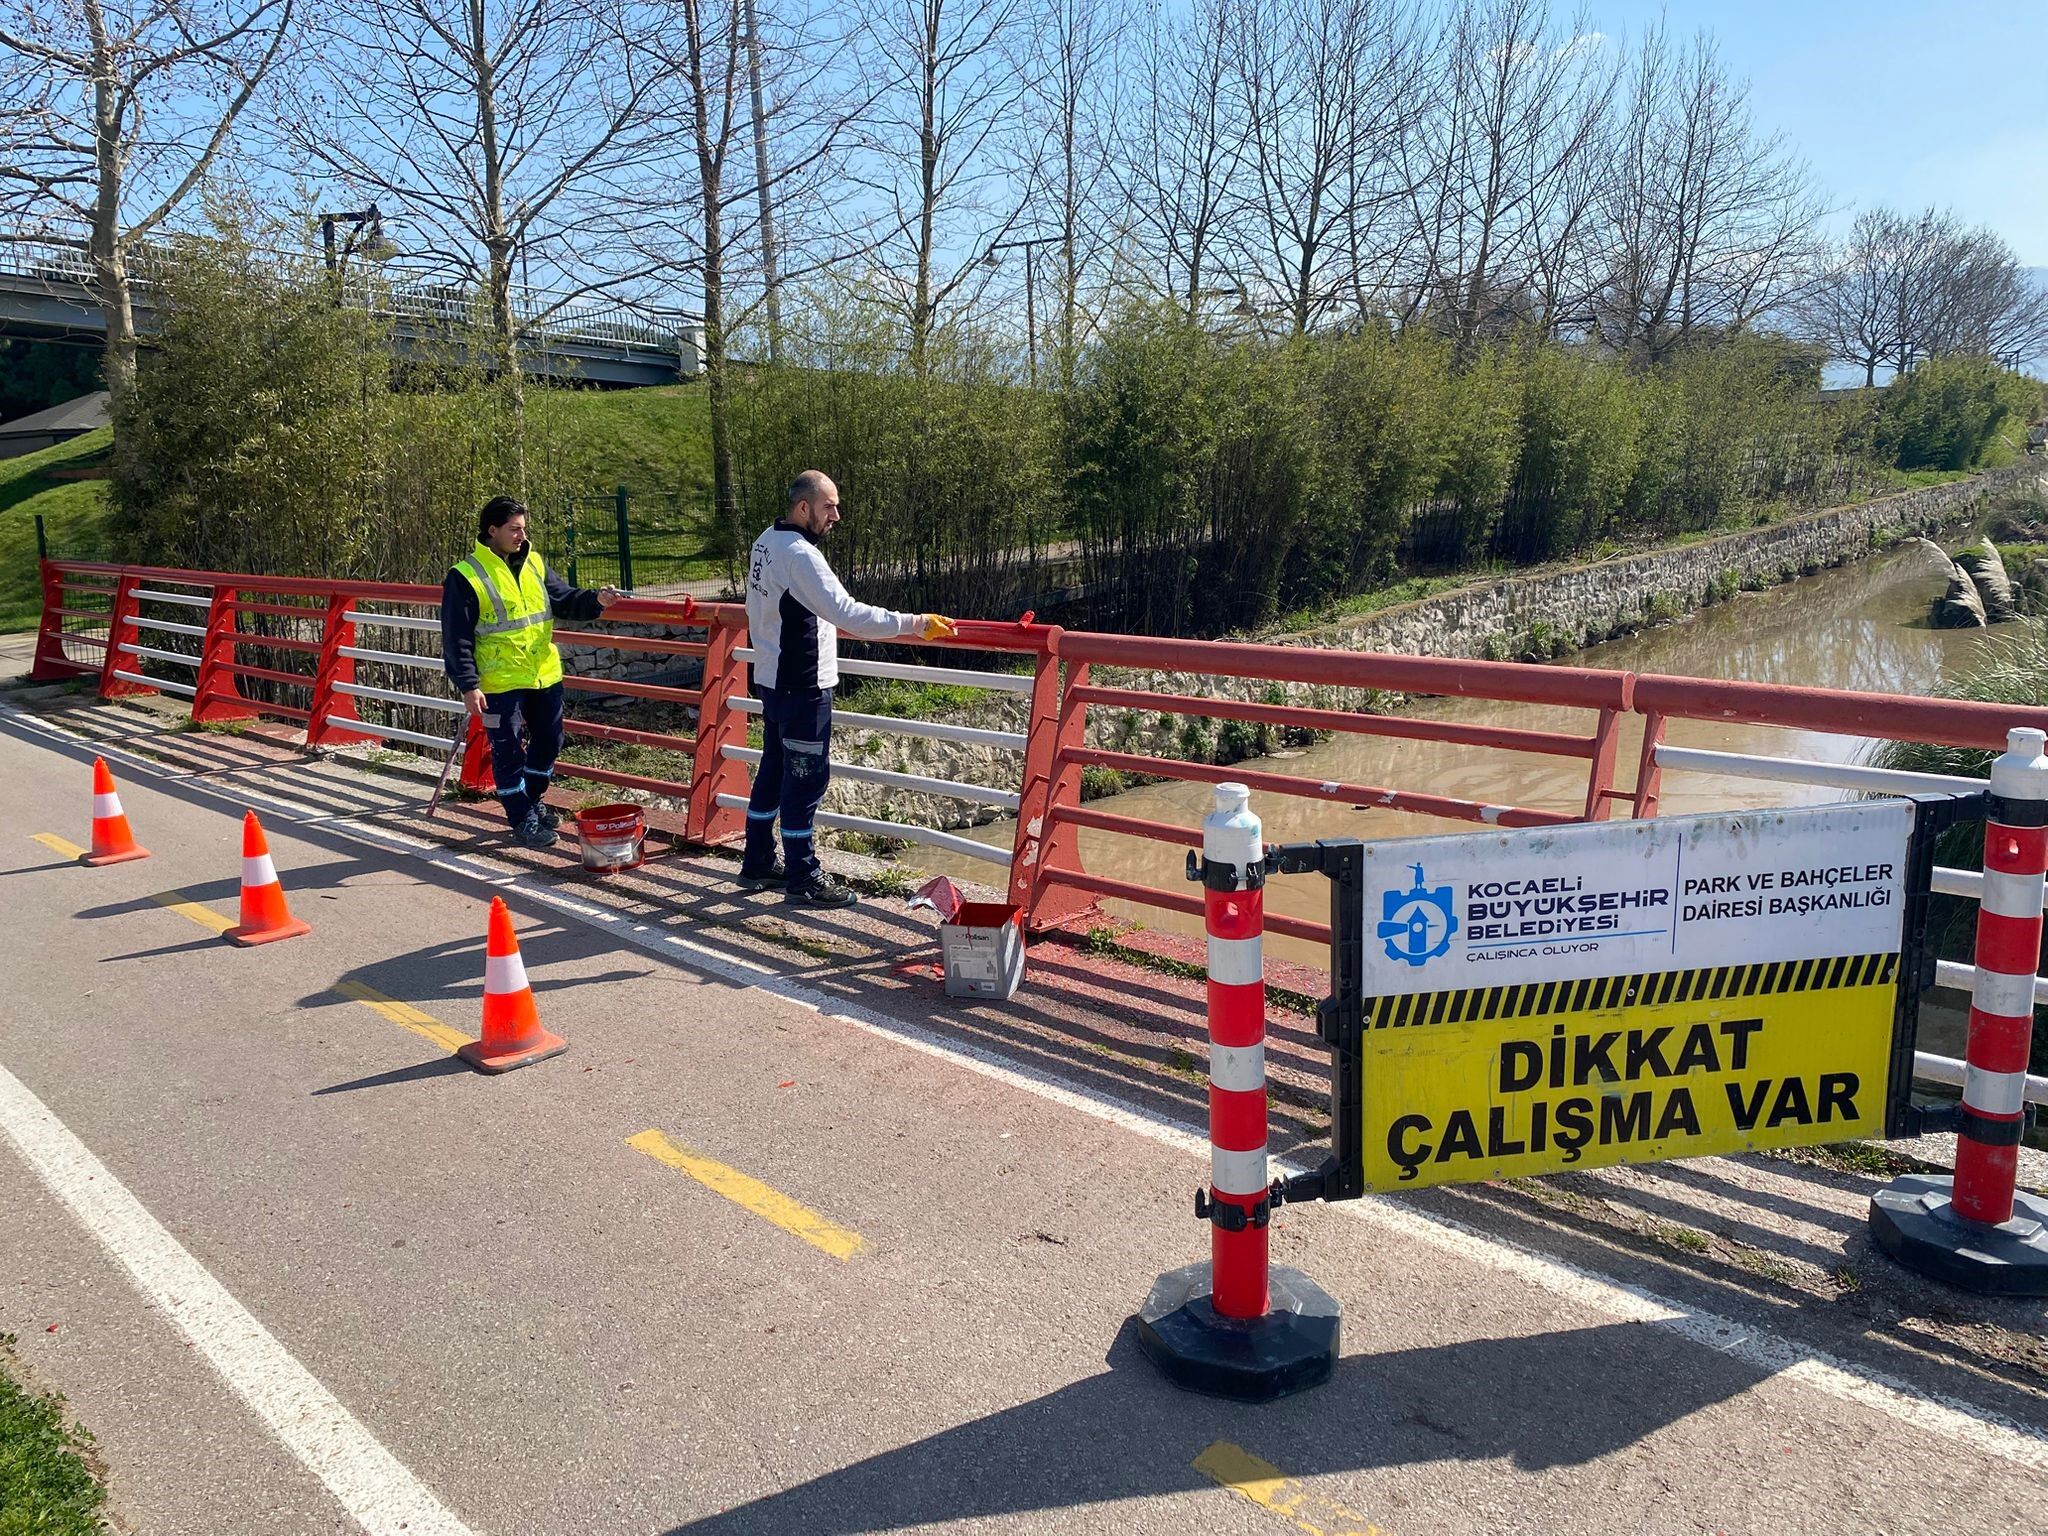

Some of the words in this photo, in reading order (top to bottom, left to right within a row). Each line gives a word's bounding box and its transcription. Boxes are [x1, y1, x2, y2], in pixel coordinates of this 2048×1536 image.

[1684, 875, 1741, 896] PARK
[1747, 872, 1774, 891] VE
[1780, 863, 1893, 888] BAHÇELER
[1682, 896, 1763, 922] DAİRESİ
[1769, 886, 1891, 916] BAŞKANLIĞI
[1466, 947, 1538, 962] ÇALIŞINCA
[1542, 942, 1599, 956] OLUYOR
[1499, 1018, 1764, 1094] DİKKAT
[1386, 1088, 1702, 1181] ÇALIŞMA
[1724, 1072, 1861, 1131] VAR
